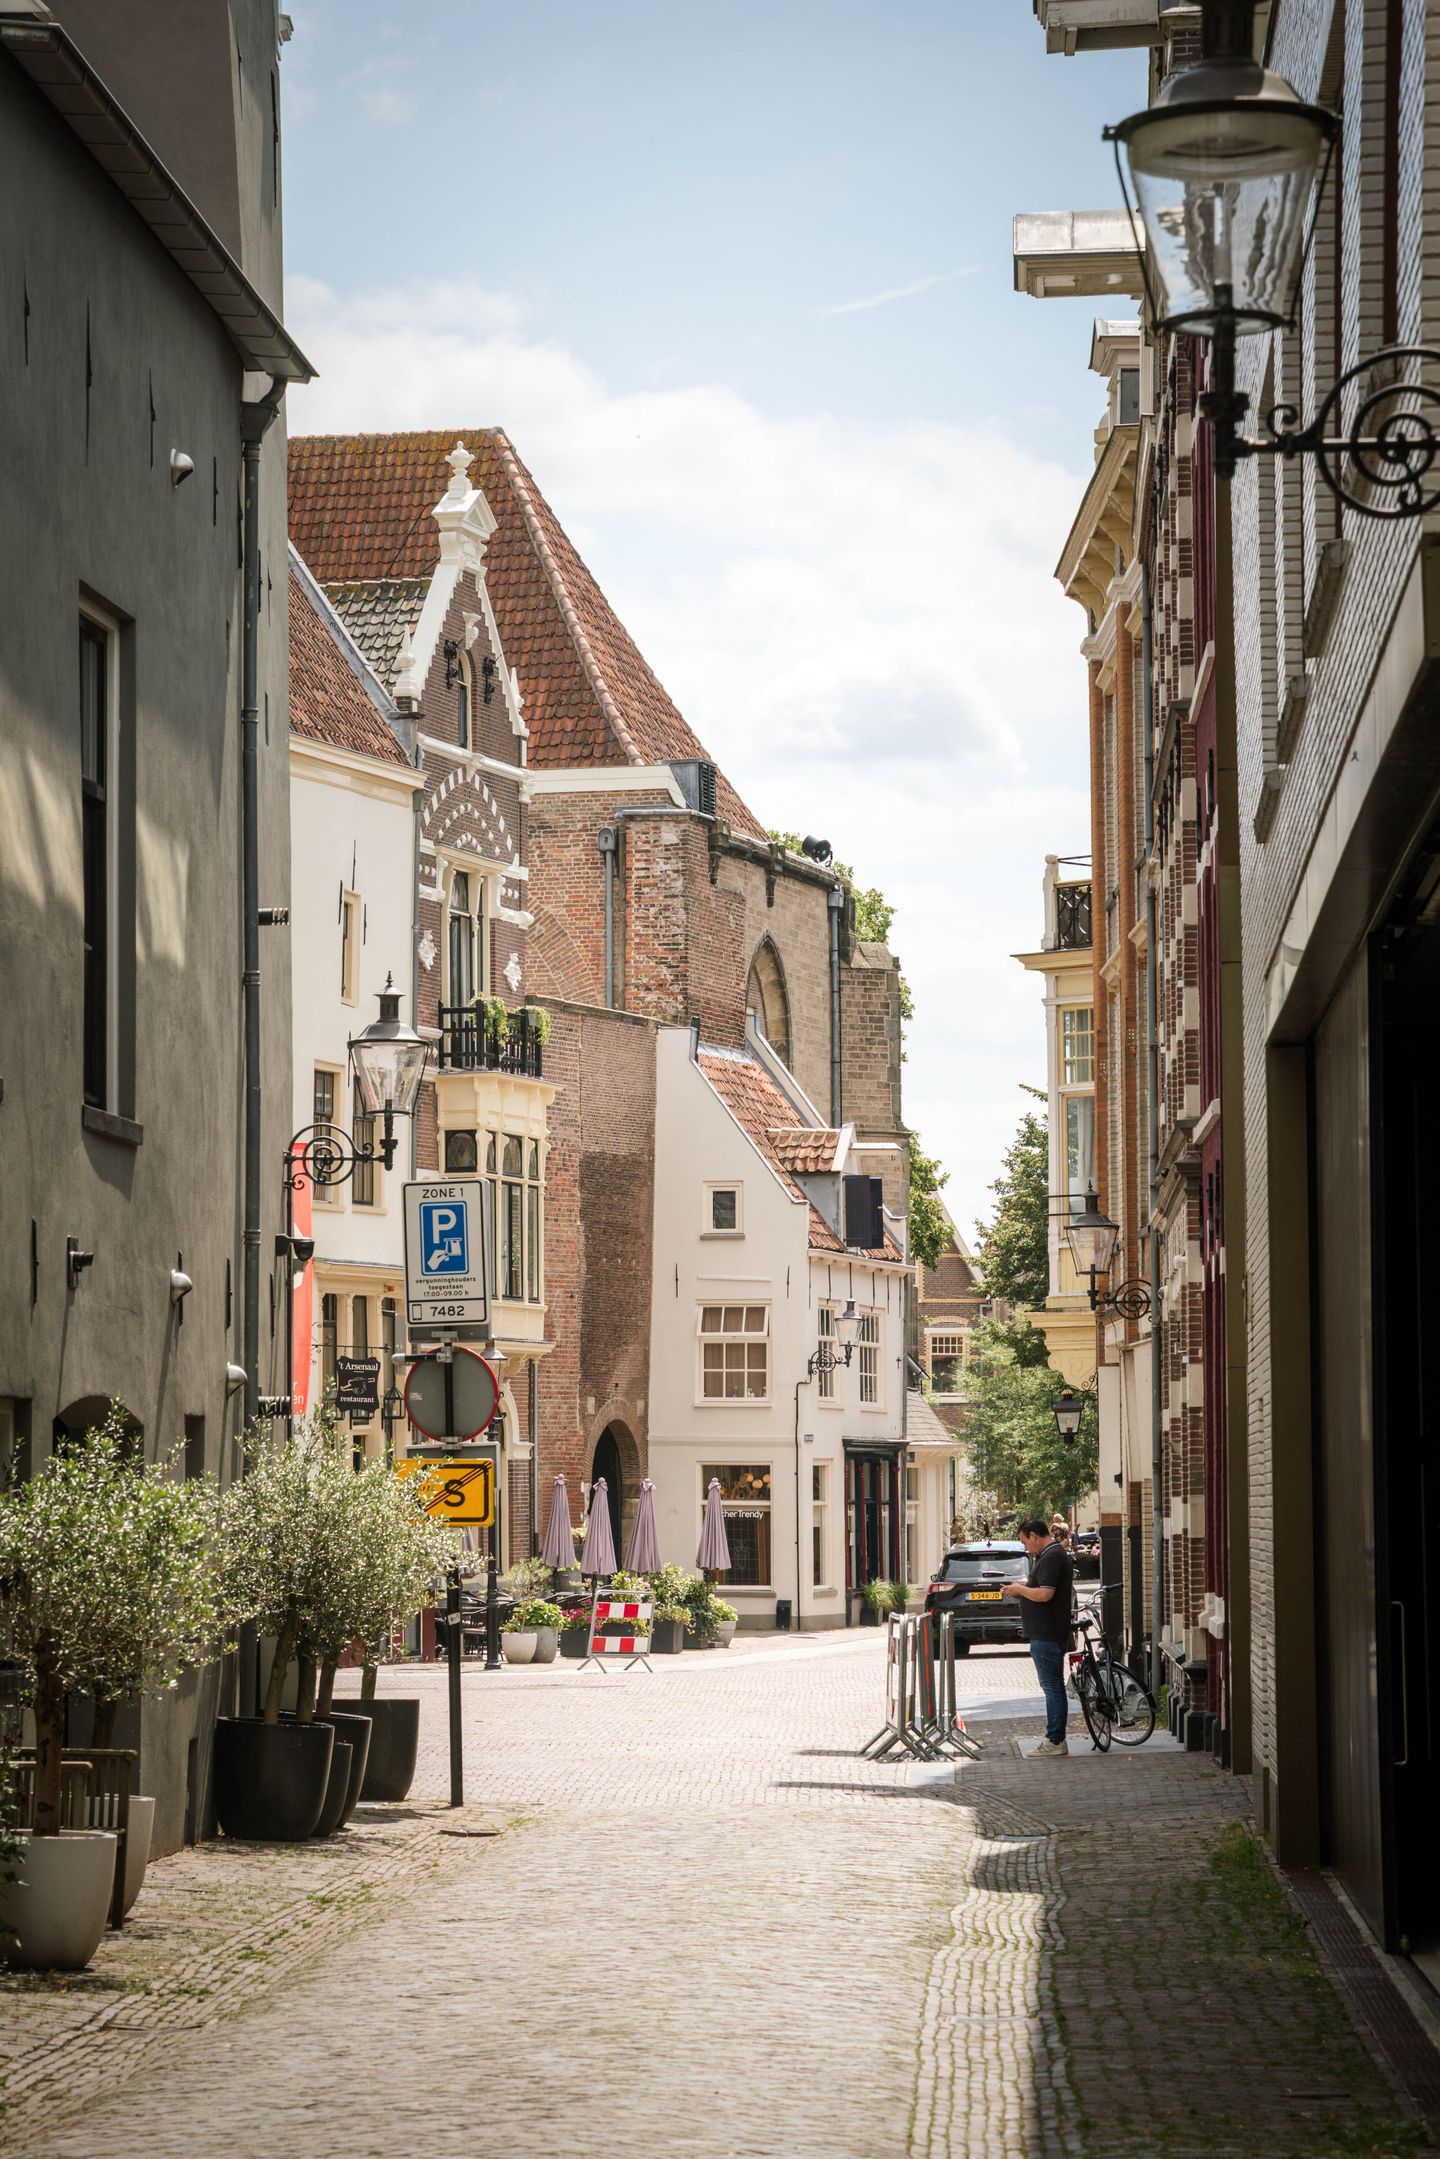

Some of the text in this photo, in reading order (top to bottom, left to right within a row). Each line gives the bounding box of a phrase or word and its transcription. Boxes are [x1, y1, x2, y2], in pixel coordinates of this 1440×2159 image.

[422, 1188, 464, 1199] ZONE 1
[432, 1208, 457, 1244] P
[415, 1276, 476, 1285] vergunninghouders
[429, 1305, 465, 1317] 7482
[338, 1361, 379, 1371] 't Arsenaal
[443, 1479, 465, 1507] S
[738, 1510, 764, 1520] Trendy
